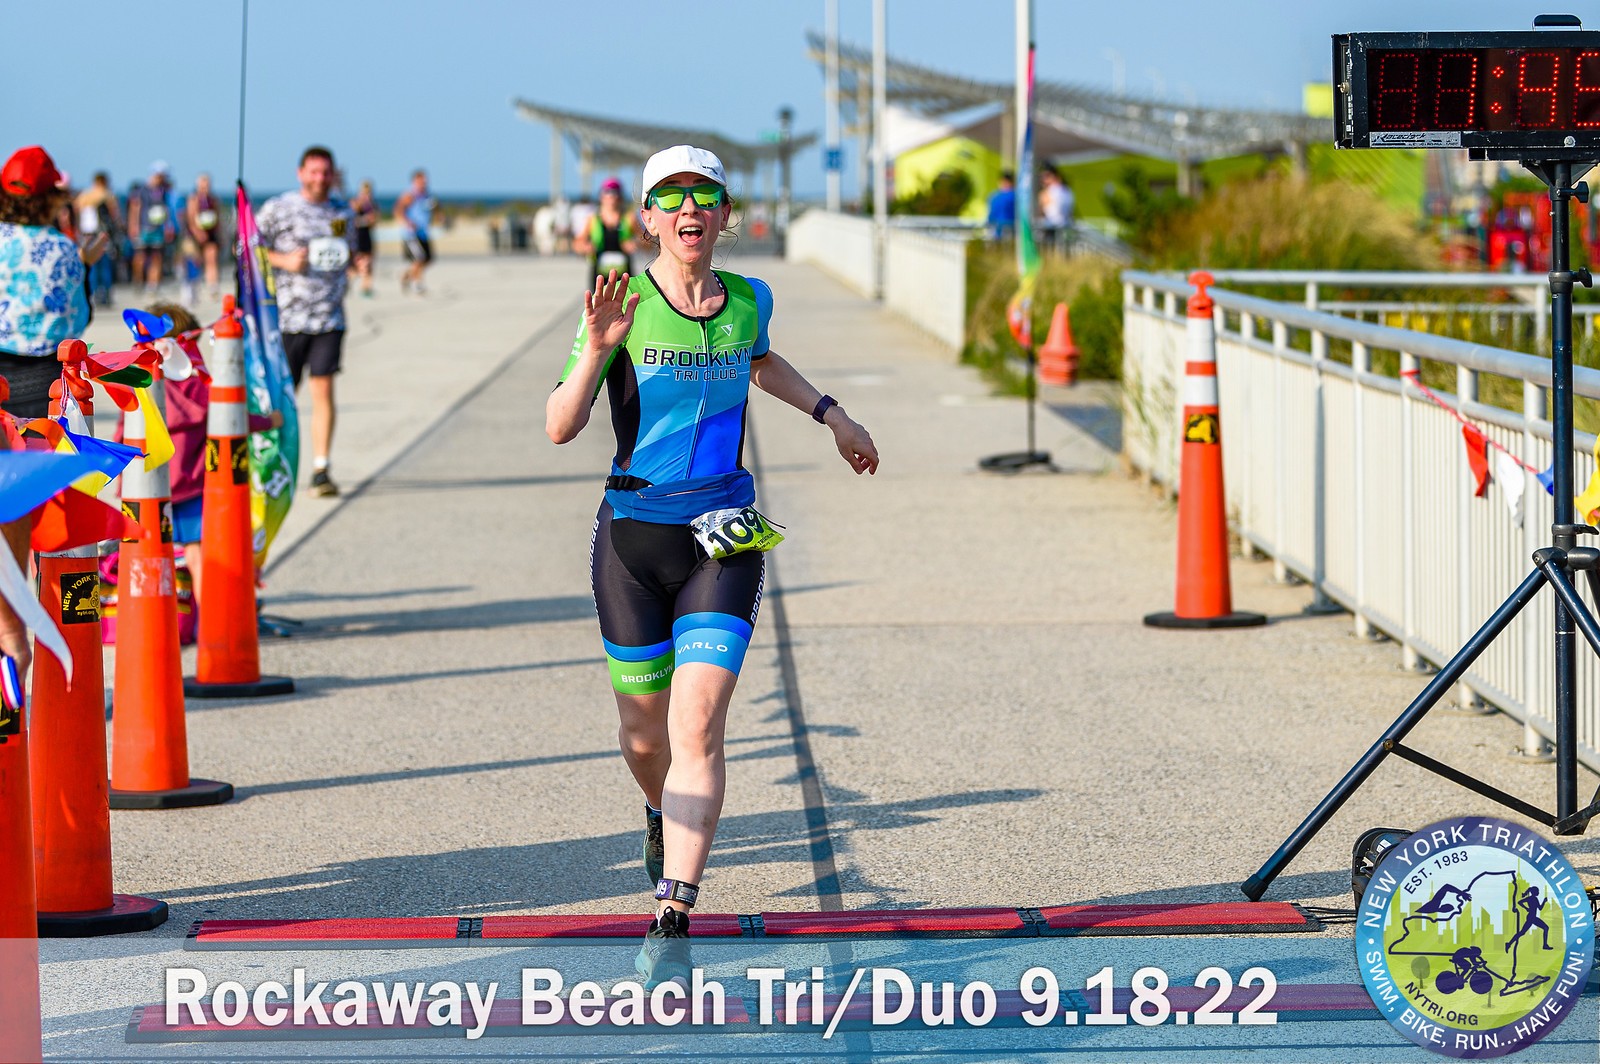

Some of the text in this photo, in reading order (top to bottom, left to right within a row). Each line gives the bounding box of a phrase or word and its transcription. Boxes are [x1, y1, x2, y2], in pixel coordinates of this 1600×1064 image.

[643, 347, 752, 368] BROOKLYN
[674, 368, 738, 382] TRI CLUB
[708, 507, 764, 555] 109
[62, 590, 73, 611] NEW
[71, 575, 92, 590] YORK
[677, 641, 729, 655] VARLO
[621, 662, 673, 684] BROOKLYN
